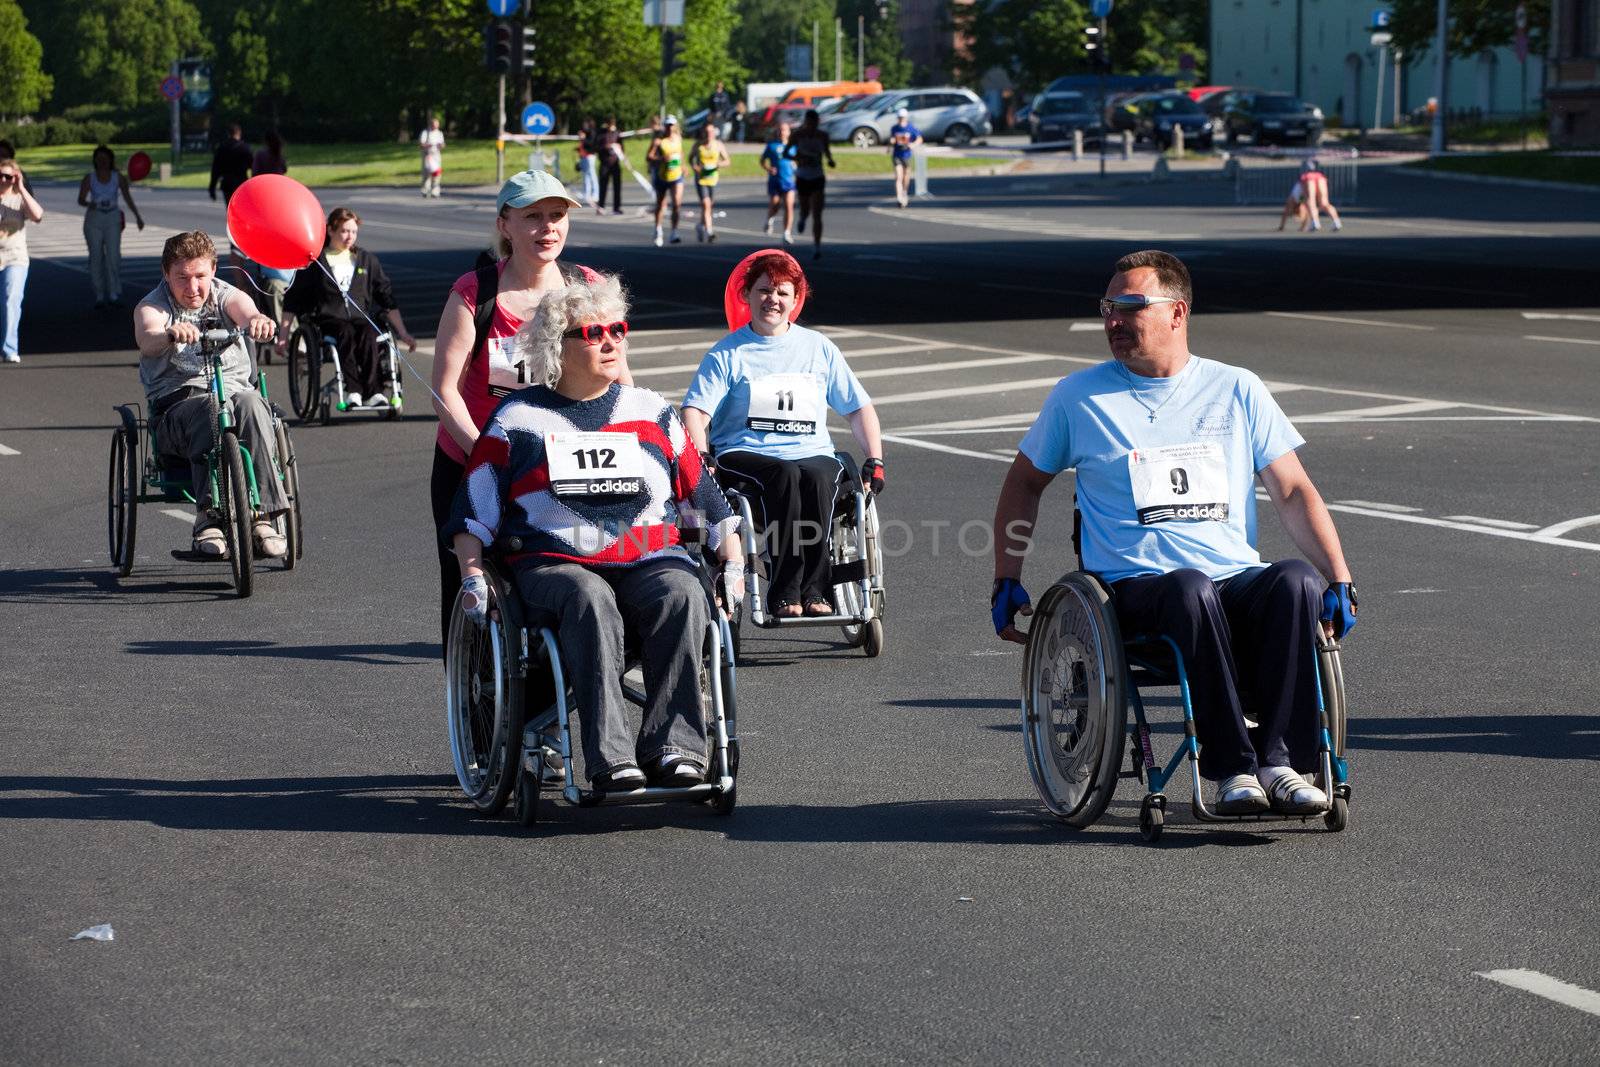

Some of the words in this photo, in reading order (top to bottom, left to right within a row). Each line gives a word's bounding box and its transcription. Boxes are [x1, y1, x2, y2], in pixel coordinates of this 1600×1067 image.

[776, 390, 794, 411] 11
[776, 421, 812, 433] adidas
[572, 448, 617, 469] 112
[589, 480, 640, 494] adidas
[1169, 467, 1190, 495] 9
[1177, 506, 1225, 519] adidas
